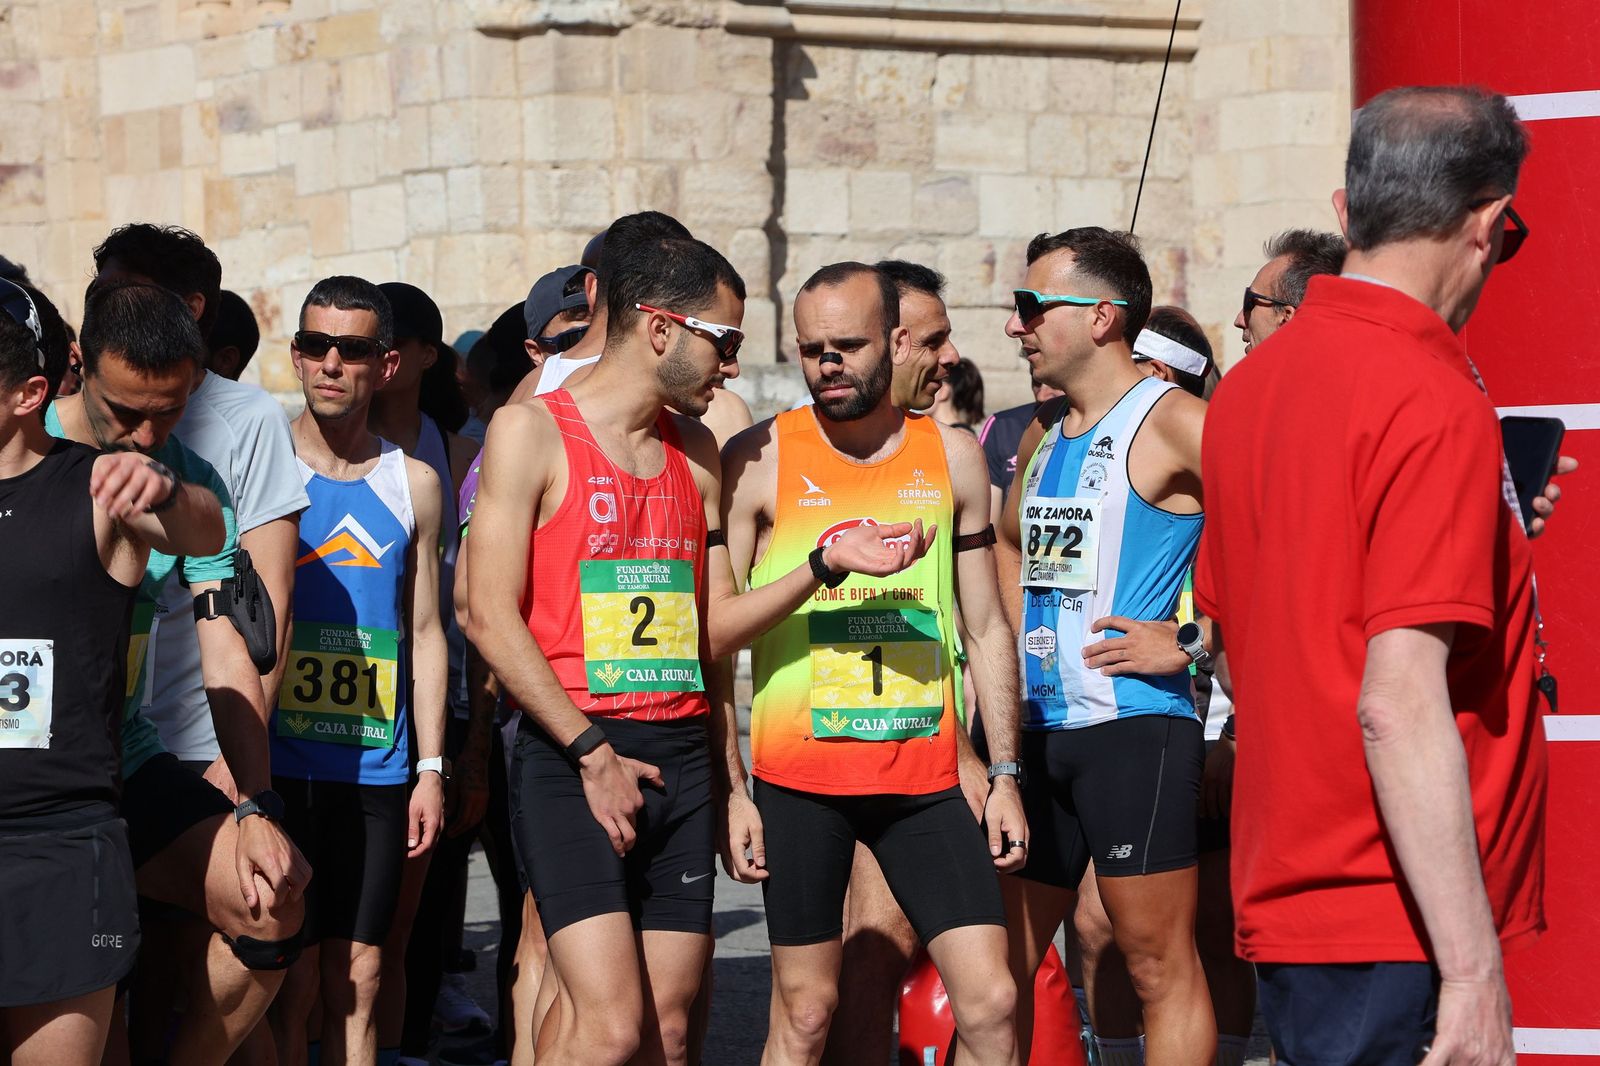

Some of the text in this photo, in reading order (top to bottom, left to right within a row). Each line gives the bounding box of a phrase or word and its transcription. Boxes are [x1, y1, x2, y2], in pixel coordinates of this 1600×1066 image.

[588, 476, 614, 485] 42K
[898, 489, 941, 499] SERRANO
[1026, 506, 1094, 521] 10K ZAMORA
[1027, 524, 1083, 558] 872
[617, 574, 671, 584] CAJA RURAL
[814, 587, 924, 601] COME BIEN Y CORRE
[629, 596, 658, 647] 2
[848, 624, 908, 634] CAJA RURAL
[320, 636, 372, 650] CAJA RURAL
[626, 668, 696, 683] CAJA RURAL
[861, 645, 883, 697] 1
[293, 656, 378, 709] 381
[1031, 684, 1056, 697] MGM
[314, 721, 388, 740] CAJA RURAL
[852, 717, 934, 732] CAJA RURAL
[91, 934, 122, 948] GORE
